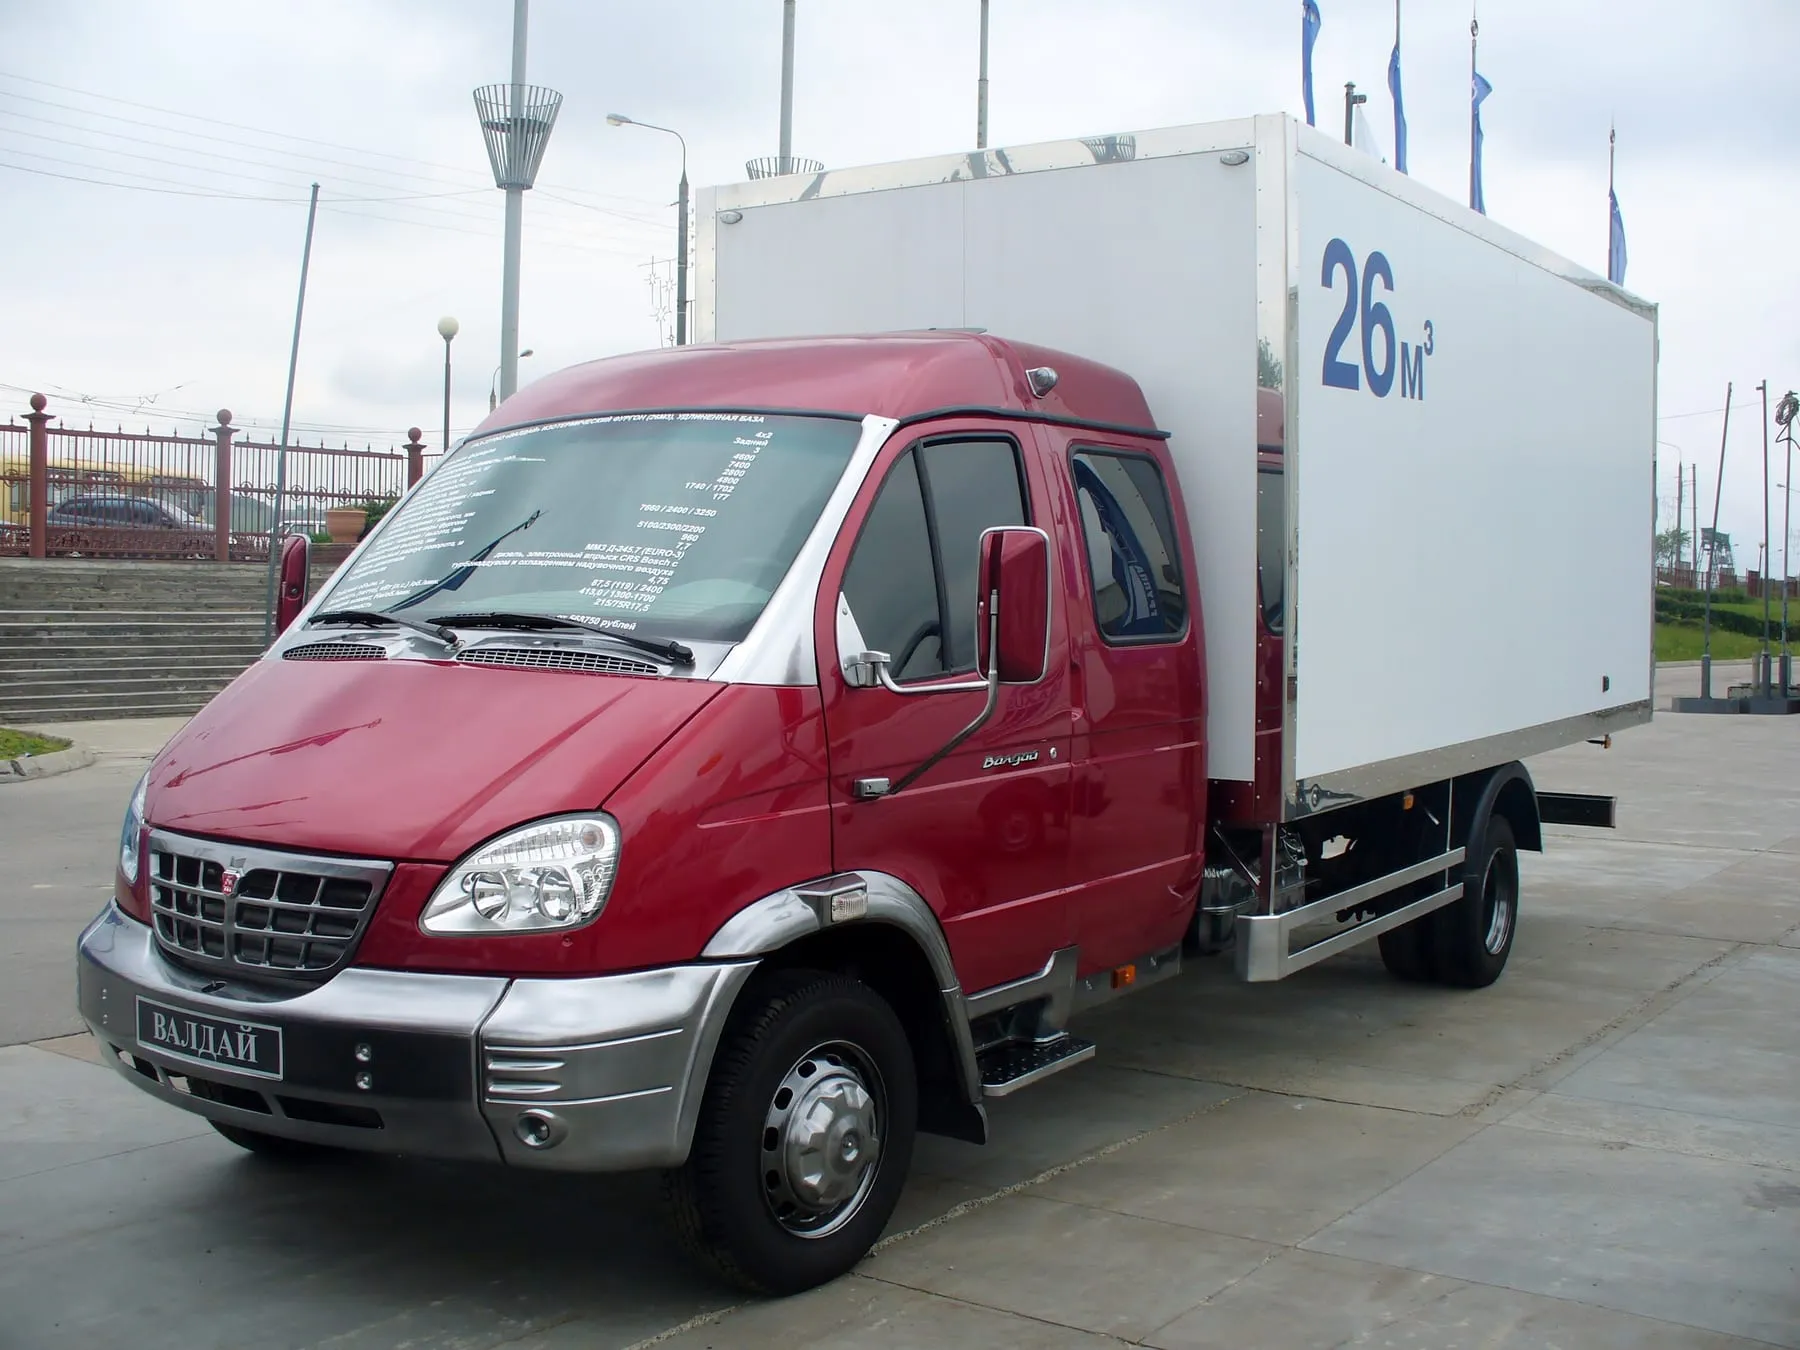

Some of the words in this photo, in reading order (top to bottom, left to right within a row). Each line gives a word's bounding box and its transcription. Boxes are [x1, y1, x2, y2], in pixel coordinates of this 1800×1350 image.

[739, 415, 765, 423] БАЗА
[733, 437, 768, 446] Задний
[727, 461, 751, 469] 7400
[640, 556, 671, 566] Bosch
[635, 566, 675, 577] воздуха
[639, 584, 664, 594] 2400
[600, 619, 637, 631] рублей
[153, 1012, 258, 1063] ВАЛДАЙ
